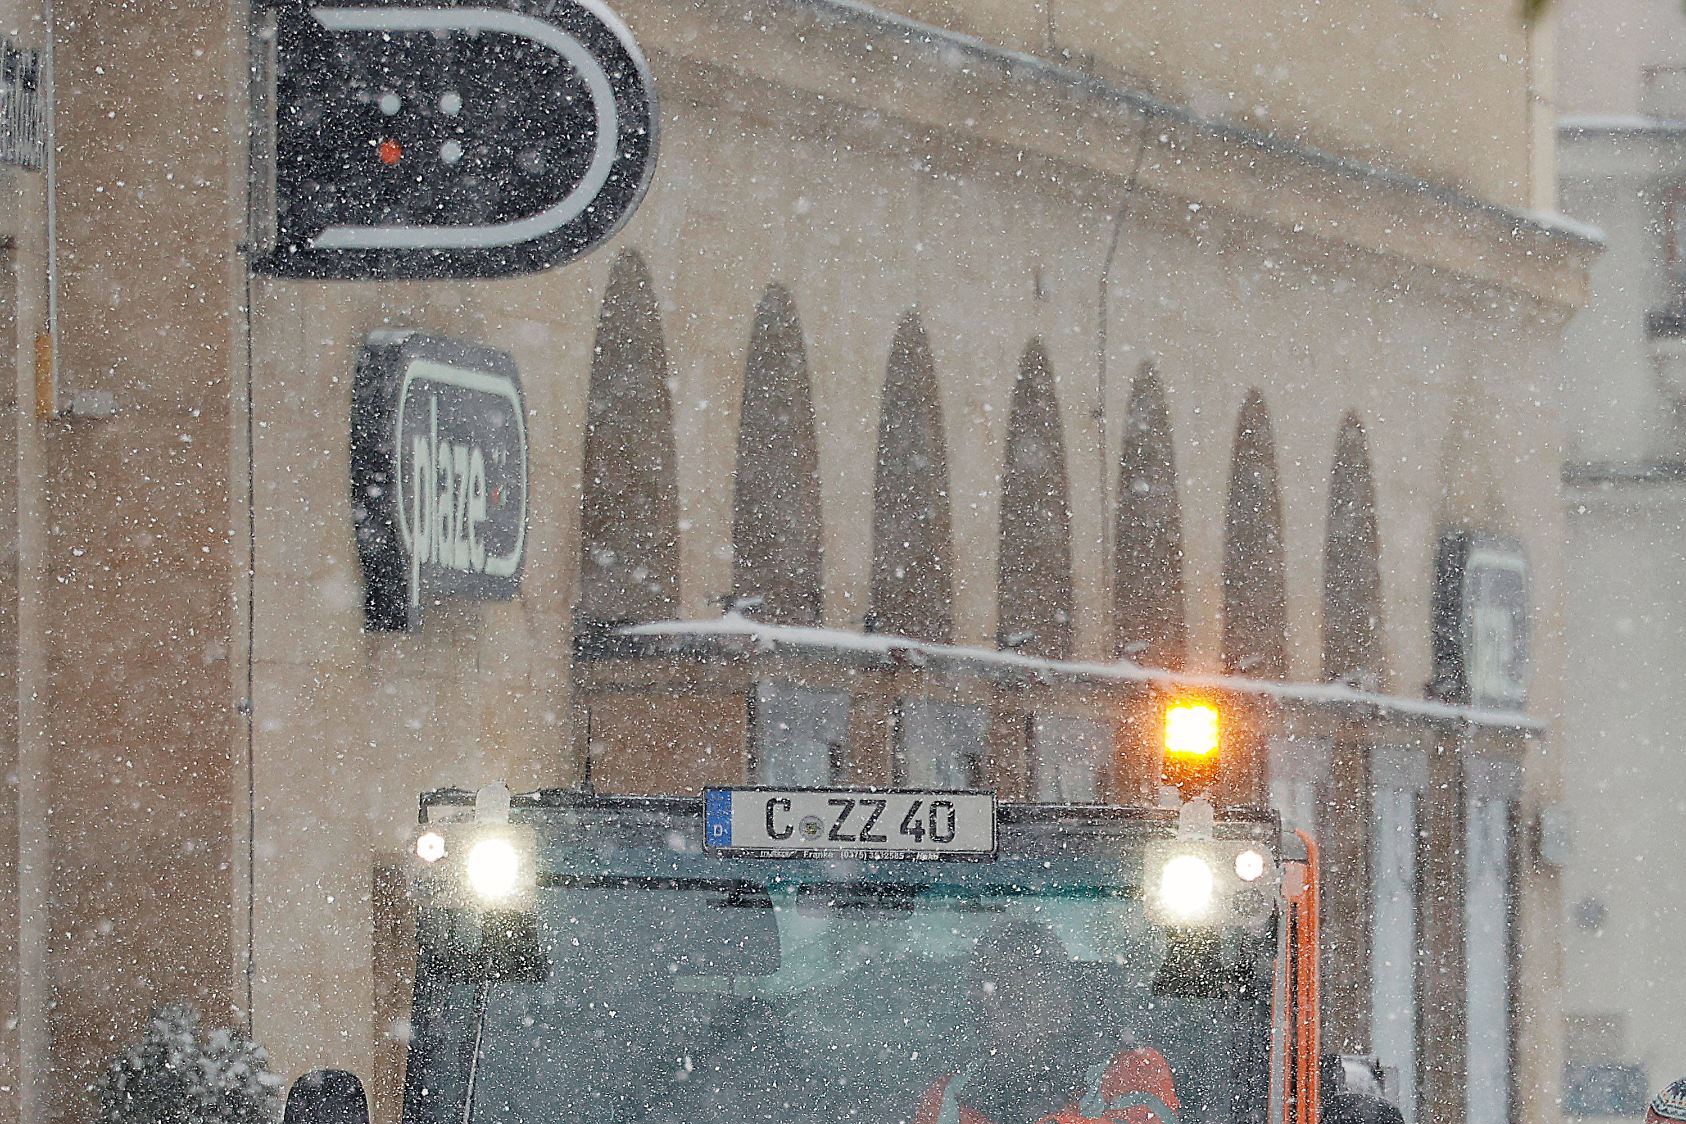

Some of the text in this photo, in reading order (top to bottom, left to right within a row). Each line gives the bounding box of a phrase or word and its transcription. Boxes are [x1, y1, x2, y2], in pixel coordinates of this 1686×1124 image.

[713, 824, 723, 837] D
[765, 797, 956, 844] C ZZ 40
